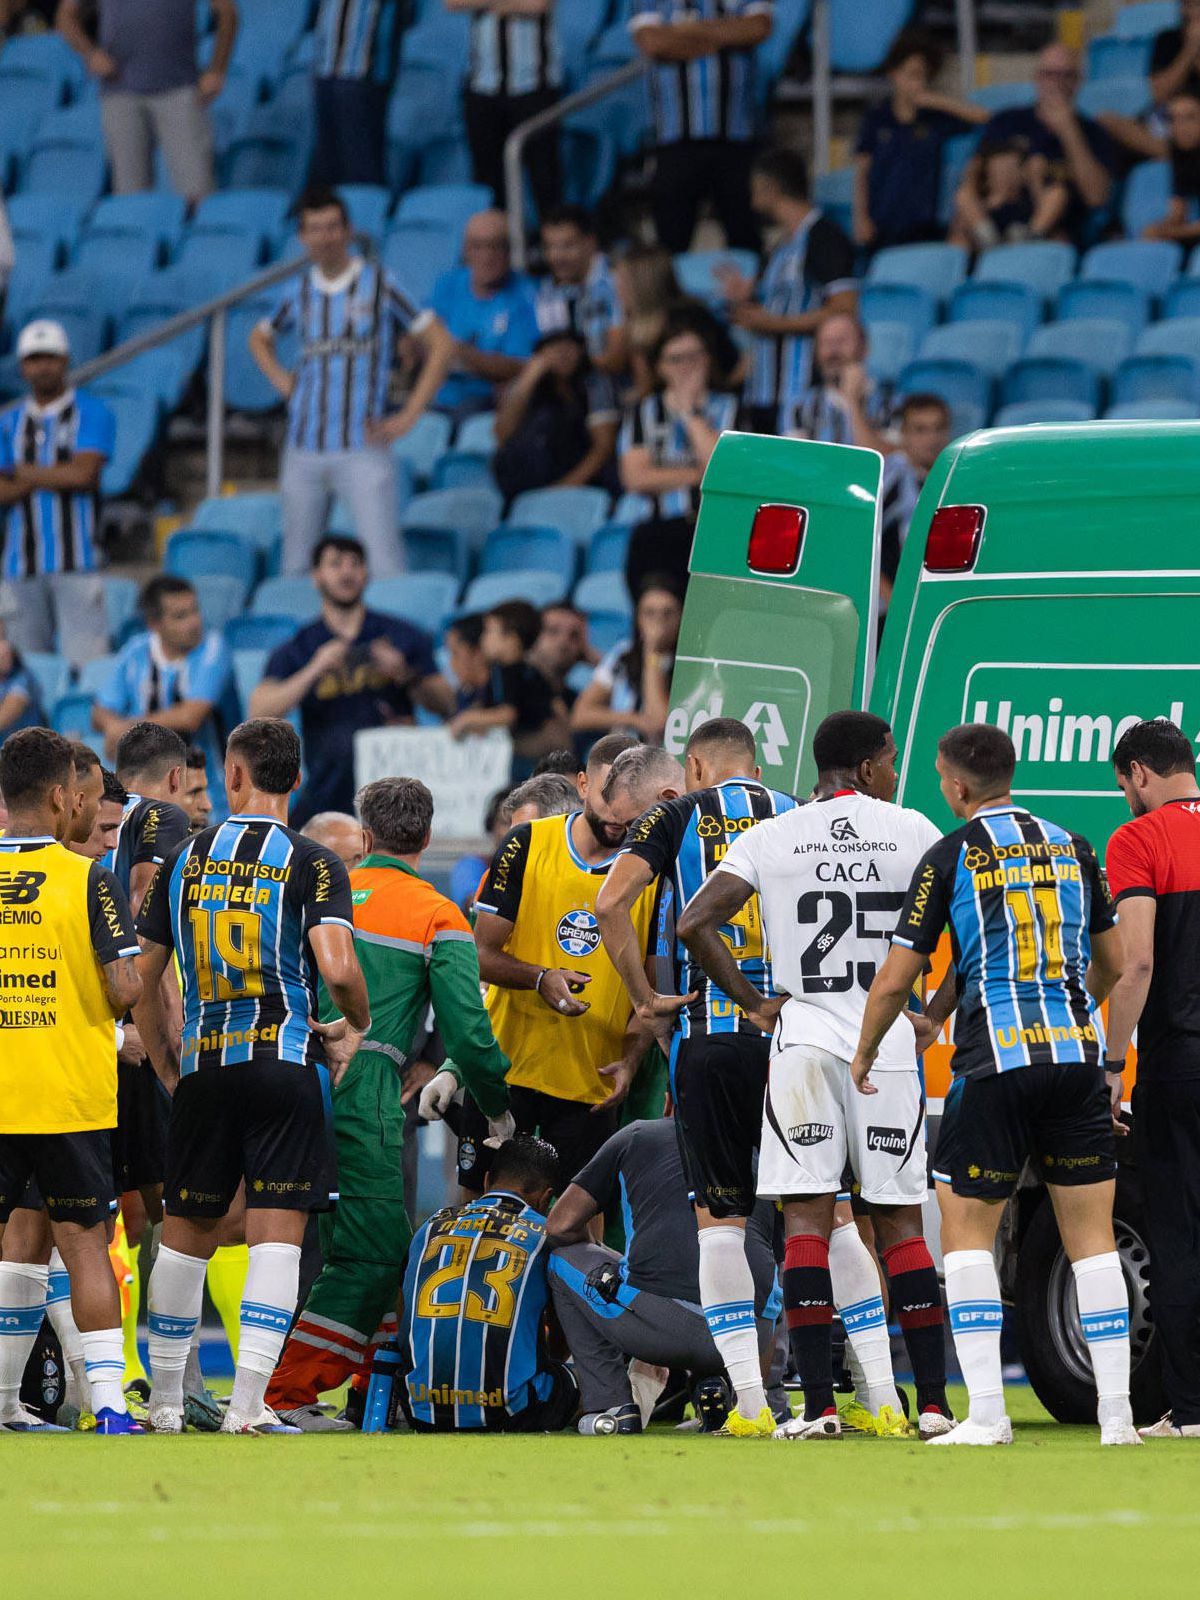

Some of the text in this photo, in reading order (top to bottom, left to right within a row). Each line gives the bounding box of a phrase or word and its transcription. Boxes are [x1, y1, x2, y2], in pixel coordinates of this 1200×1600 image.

[793, 840, 898, 855] ALPHA CONSÓRCIO
[993, 842, 1076, 861] banrisul
[203, 856, 291, 883] banrisul
[493, 836, 523, 893] HAVAN
[815, 858, 882, 882] CACÁ
[311, 857, 331, 903] HAVAN
[973, 864, 1081, 891] MONSALVE
[187, 884, 271, 906] NORIEGA
[907, 864, 936, 928] HAVAN
[0, 906, 42, 925] ÊMIO
[97, 879, 125, 939] HAVAN
[797, 891, 908, 993] 25
[1006, 888, 1065, 982] 11
[189, 906, 265, 1002] 19
[25, 994, 57, 1006] Alegre
[183, 1023, 279, 1058] Unimed
[996, 1023, 1097, 1048] Unimed
[788, 1124, 834, 1141] VAPT BLUE
[868, 1131, 906, 1151] Iquine
[267, 1181, 312, 1194] ingresse
[417, 1234, 530, 1329] 23
[1081, 1319, 1125, 1333] BPA
[409, 1383, 503, 1408] Unimed
